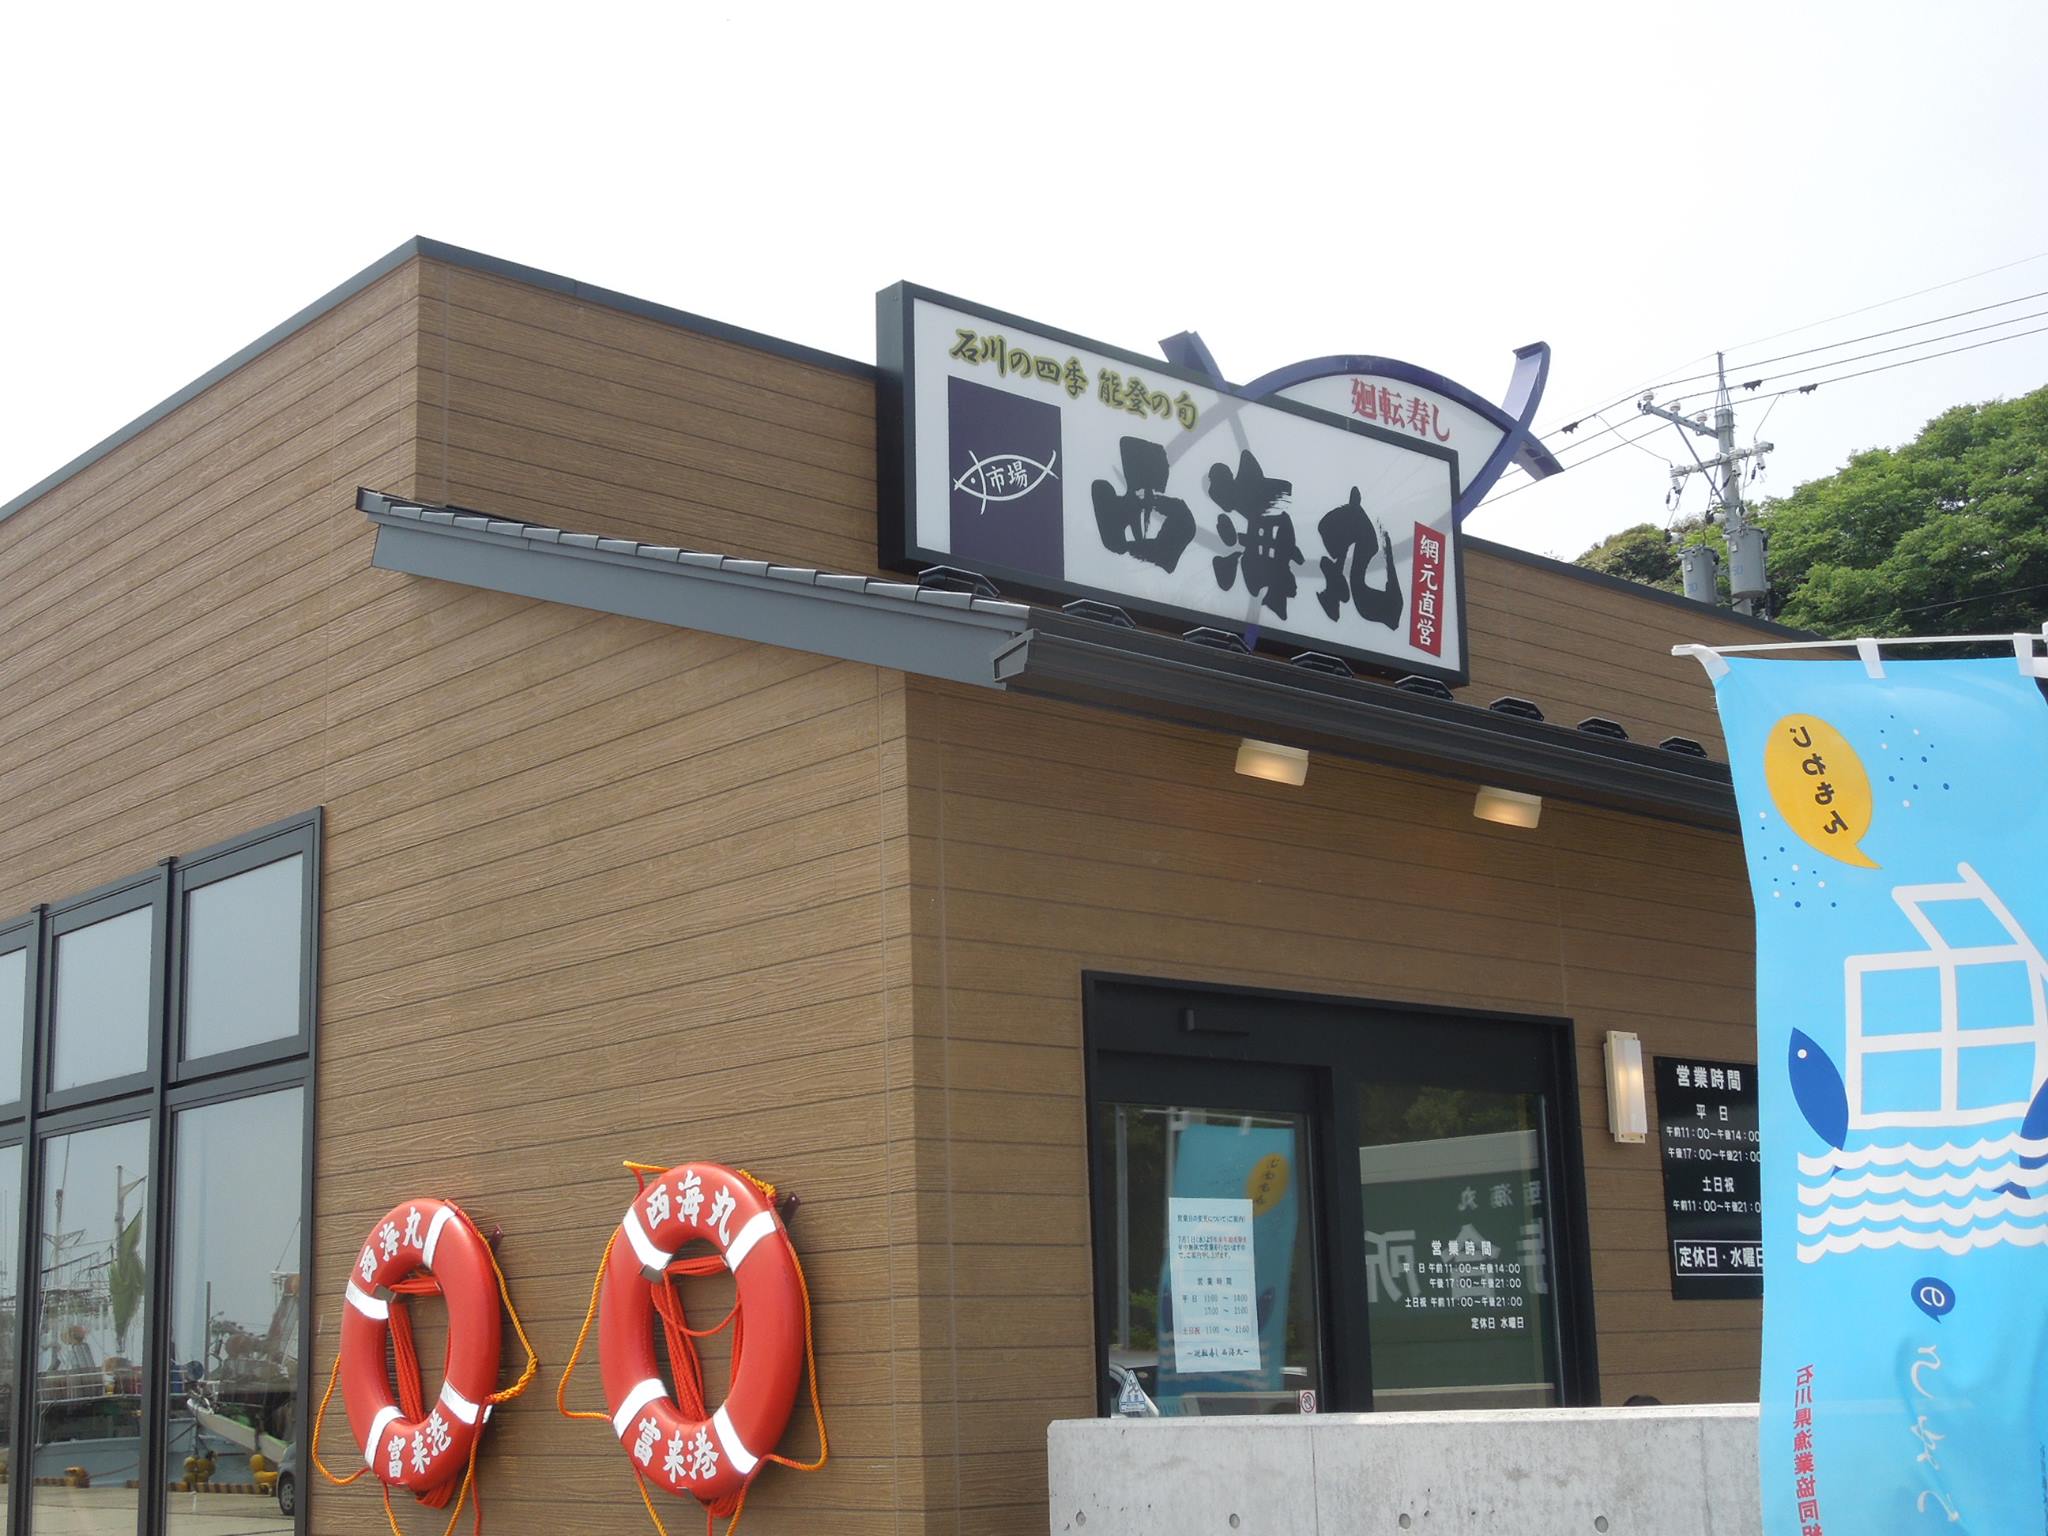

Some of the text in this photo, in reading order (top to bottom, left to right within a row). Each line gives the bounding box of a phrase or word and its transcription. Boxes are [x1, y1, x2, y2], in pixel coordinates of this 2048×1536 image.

[950, 329, 1198, 430] 石川の四季 能登の旬
[1350, 377, 1451, 442] 廻転寿し
[985, 461, 1028, 494] 市場
[1091, 436, 1404, 631] 西海丸
[1417, 534, 1440, 646] 網元直営
[1676, 1064, 1742, 1091] 営業時間
[646, 1169, 736, 1247] 西海丸
[1702, 1176, 1735, 1193] 土日祝
[359, 1206, 423, 1284] 西海丸
[1431, 1240, 1492, 1256] 営業時間
[1471, 1316, 1525, 1330] 定休日 水曜日
[633, 1416, 720, 1484] 富来港
